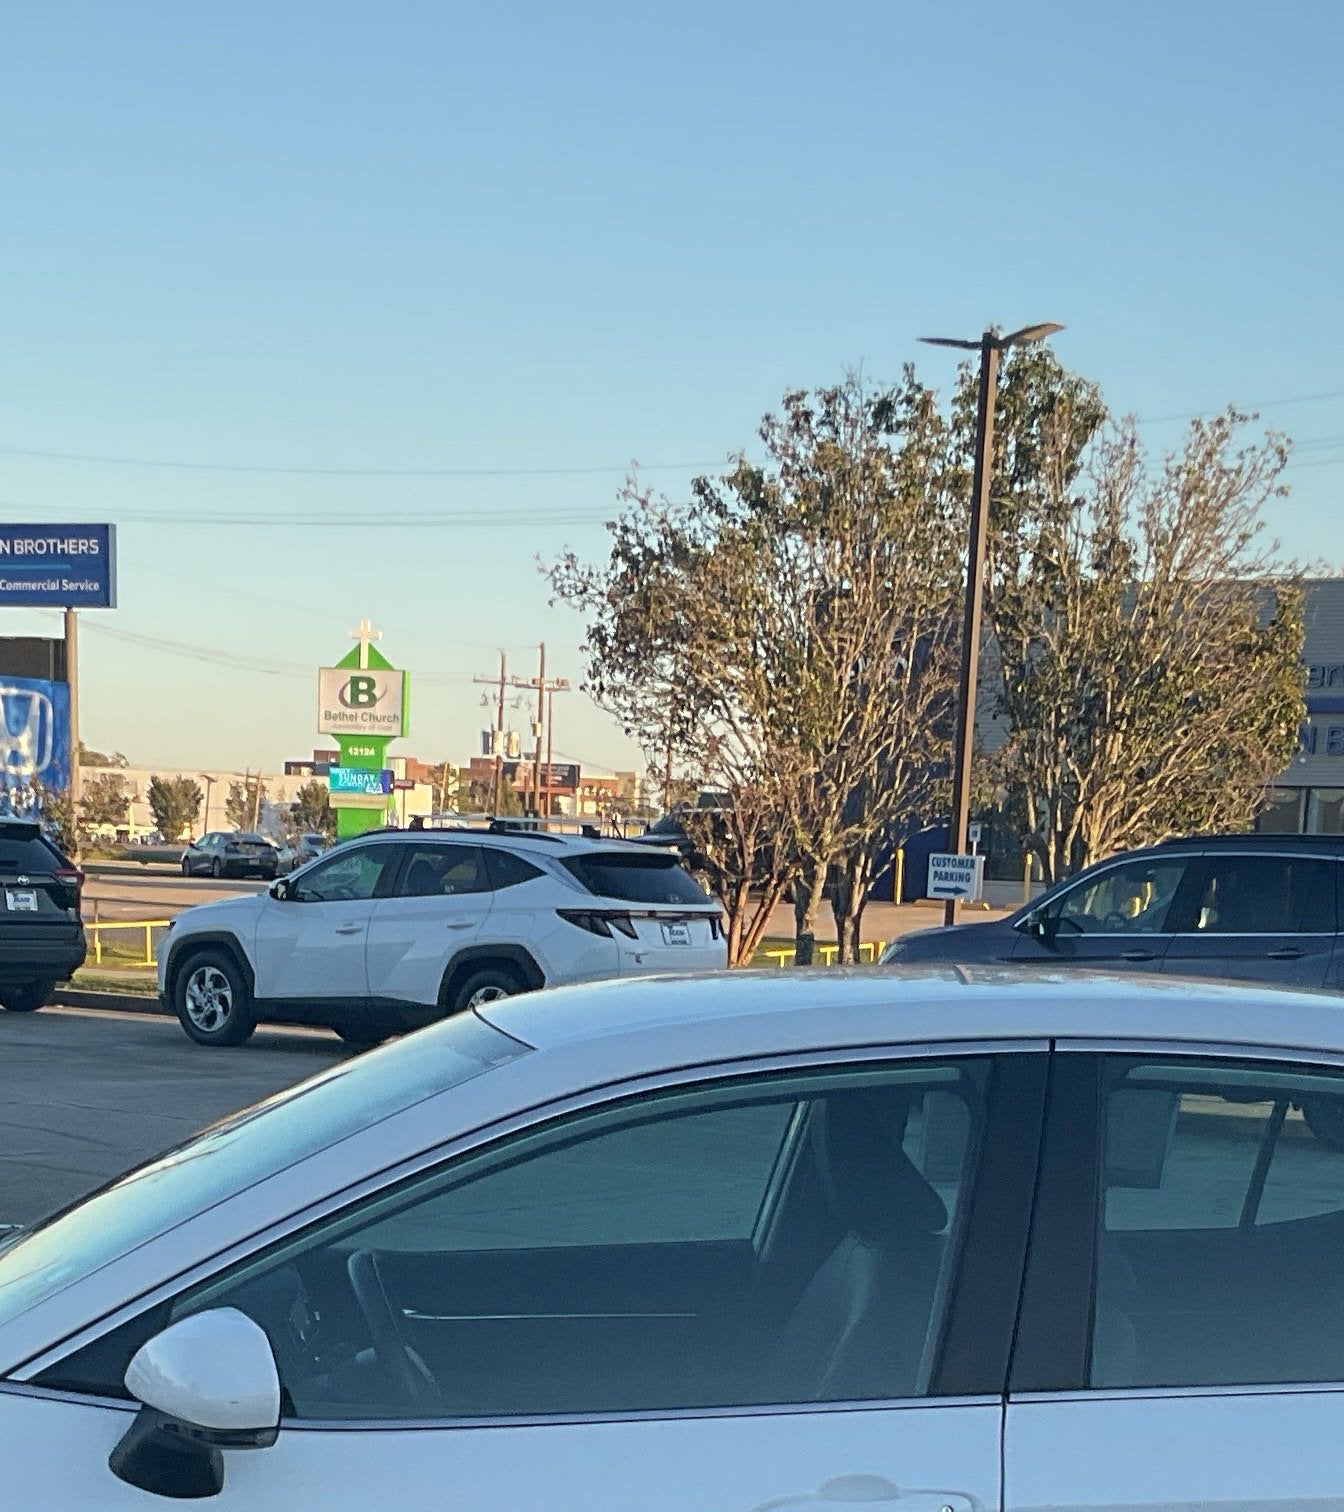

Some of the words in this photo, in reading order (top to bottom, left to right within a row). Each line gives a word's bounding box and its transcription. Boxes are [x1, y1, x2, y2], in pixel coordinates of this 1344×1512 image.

[14, 539, 99, 555] BROTHERS
[0, 578, 60, 592] Commercial
[62, 579, 99, 592] Service
[350, 676, 377, 706] B
[324, 710, 358, 721] Bethel
[361, 711, 400, 723] Church
[932, 857, 975, 869] CUSTOMER
[933, 871, 971, 883] PARKING
